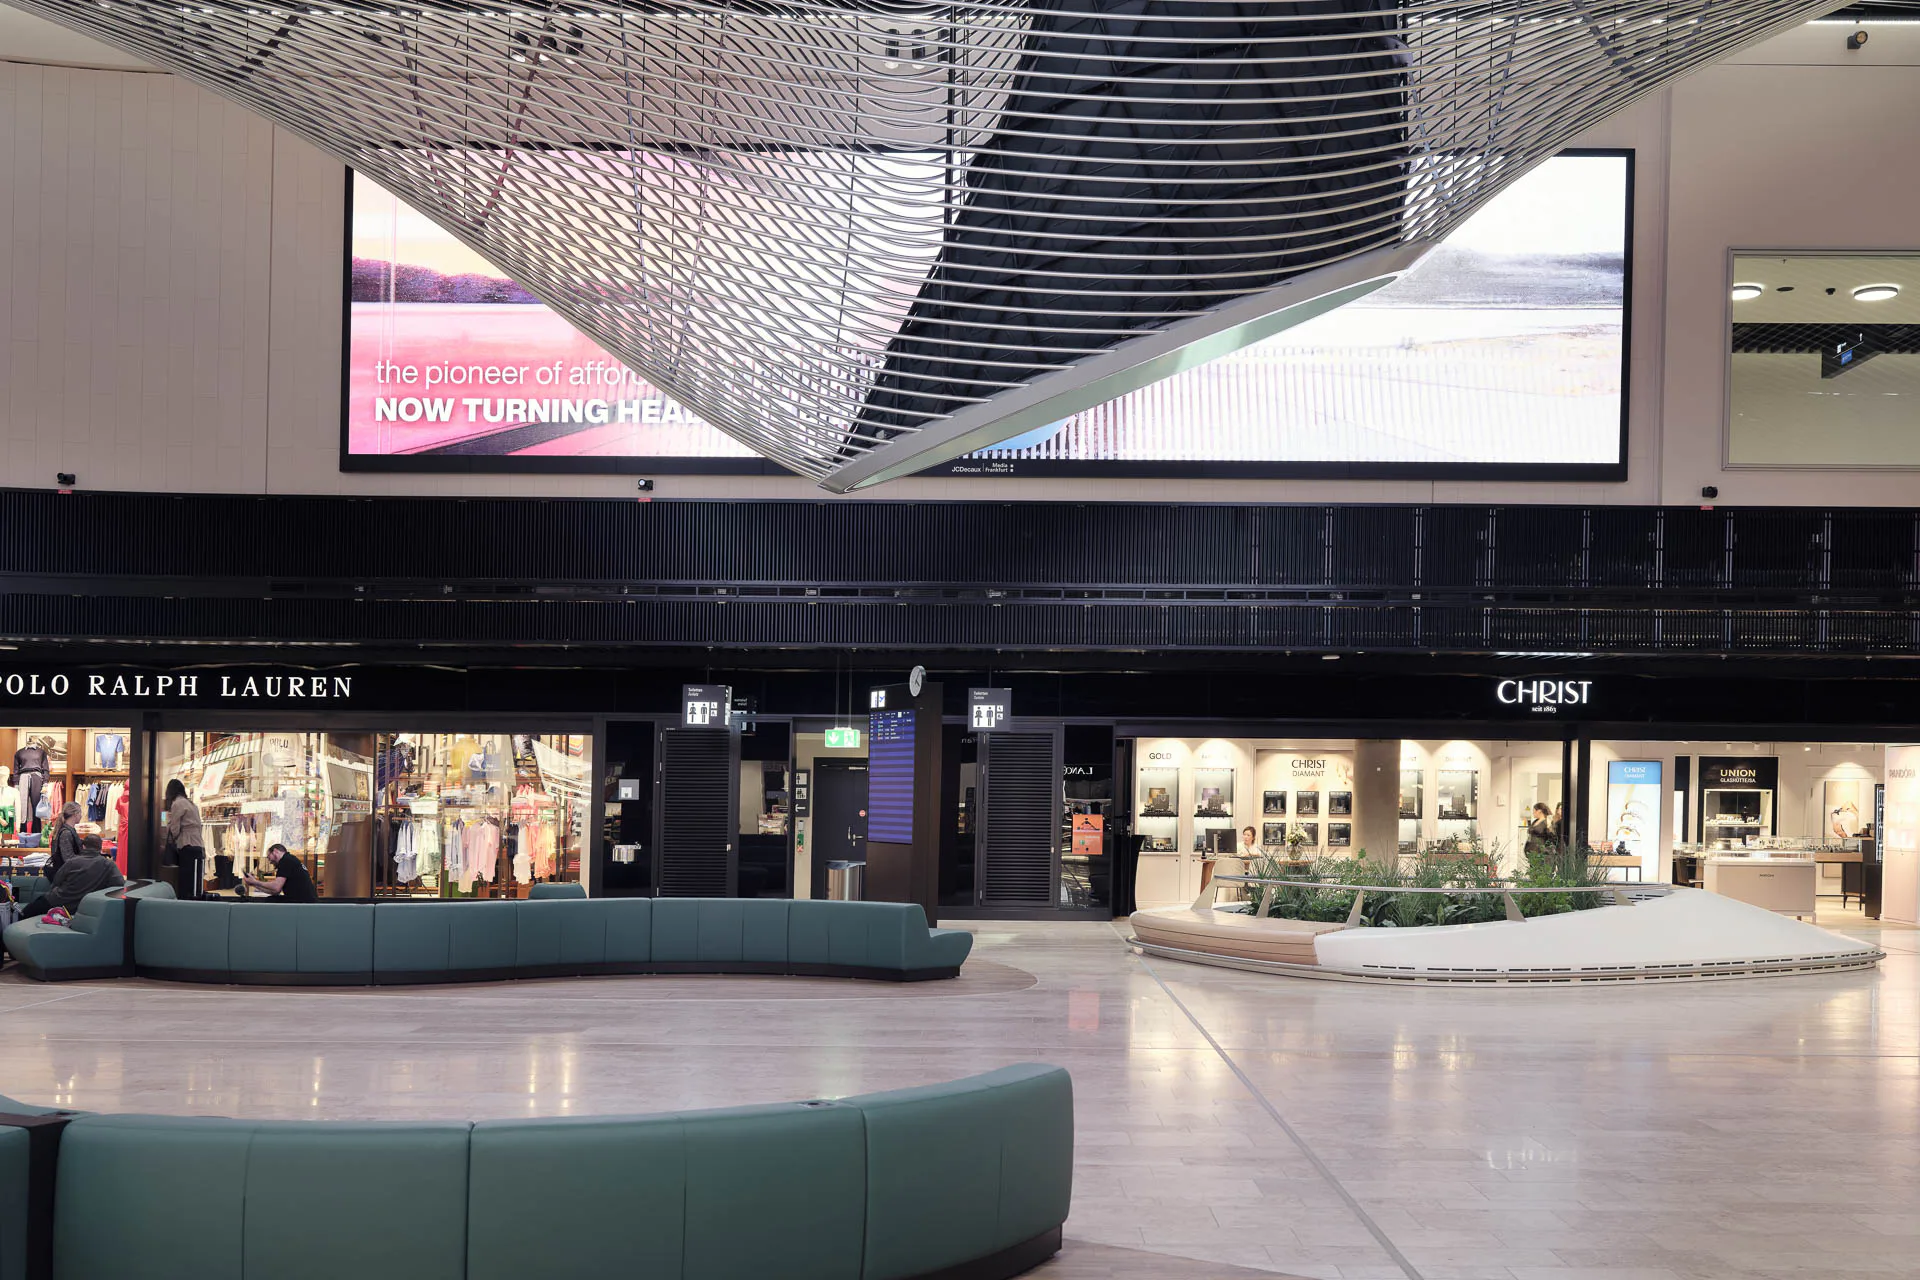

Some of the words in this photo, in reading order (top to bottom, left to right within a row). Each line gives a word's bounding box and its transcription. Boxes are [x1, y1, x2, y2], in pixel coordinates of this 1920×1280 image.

[375, 360, 418, 384] the
[425, 360, 529, 390] pioneer
[536, 361, 562, 384] of
[375, 398, 455, 422] NOW
[462, 398, 609, 423] TURNING
[0, 674, 69, 695] OLO
[88, 675, 198, 696] RALPH
[221, 676, 352, 697] LAUREN
[1497, 680, 1593, 704] CHRIST
[1148, 752, 1172, 760] GOLD
[1291, 759, 1326, 769] CHRIST
[1720, 769, 1756, 777] UNION
